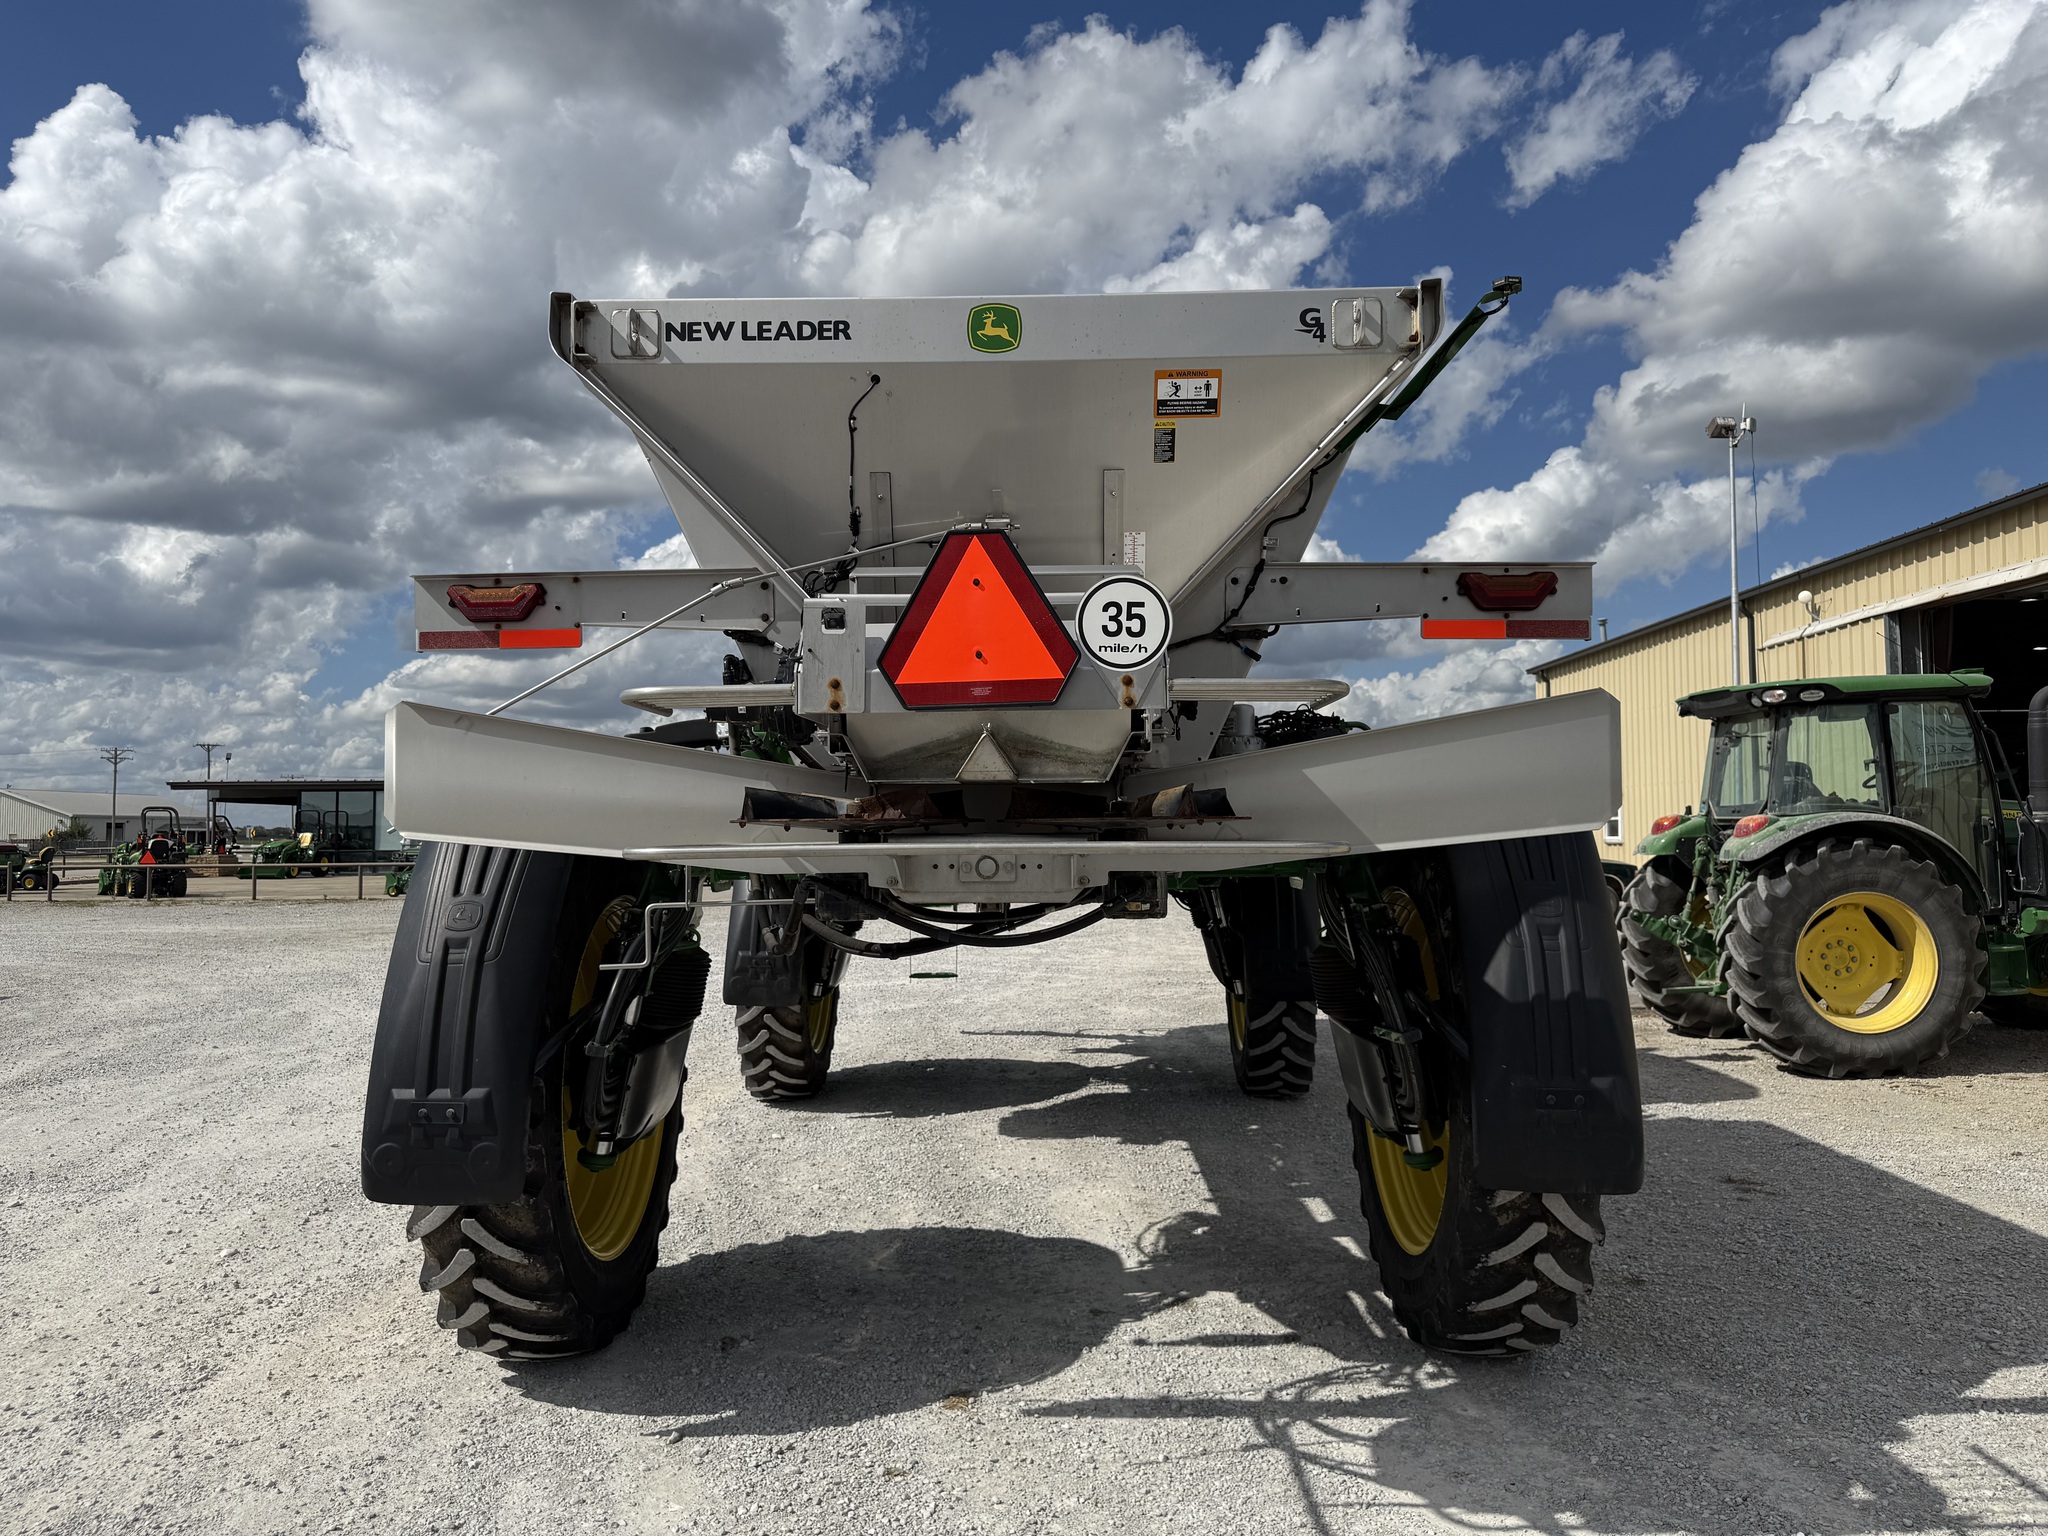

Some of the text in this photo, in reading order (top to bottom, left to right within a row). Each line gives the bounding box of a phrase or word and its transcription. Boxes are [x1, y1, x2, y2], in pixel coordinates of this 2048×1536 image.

[665, 320, 852, 342] NEW LEADER
[1101, 601, 1146, 638] 35
[1098, 643, 1148, 653] mile/h
